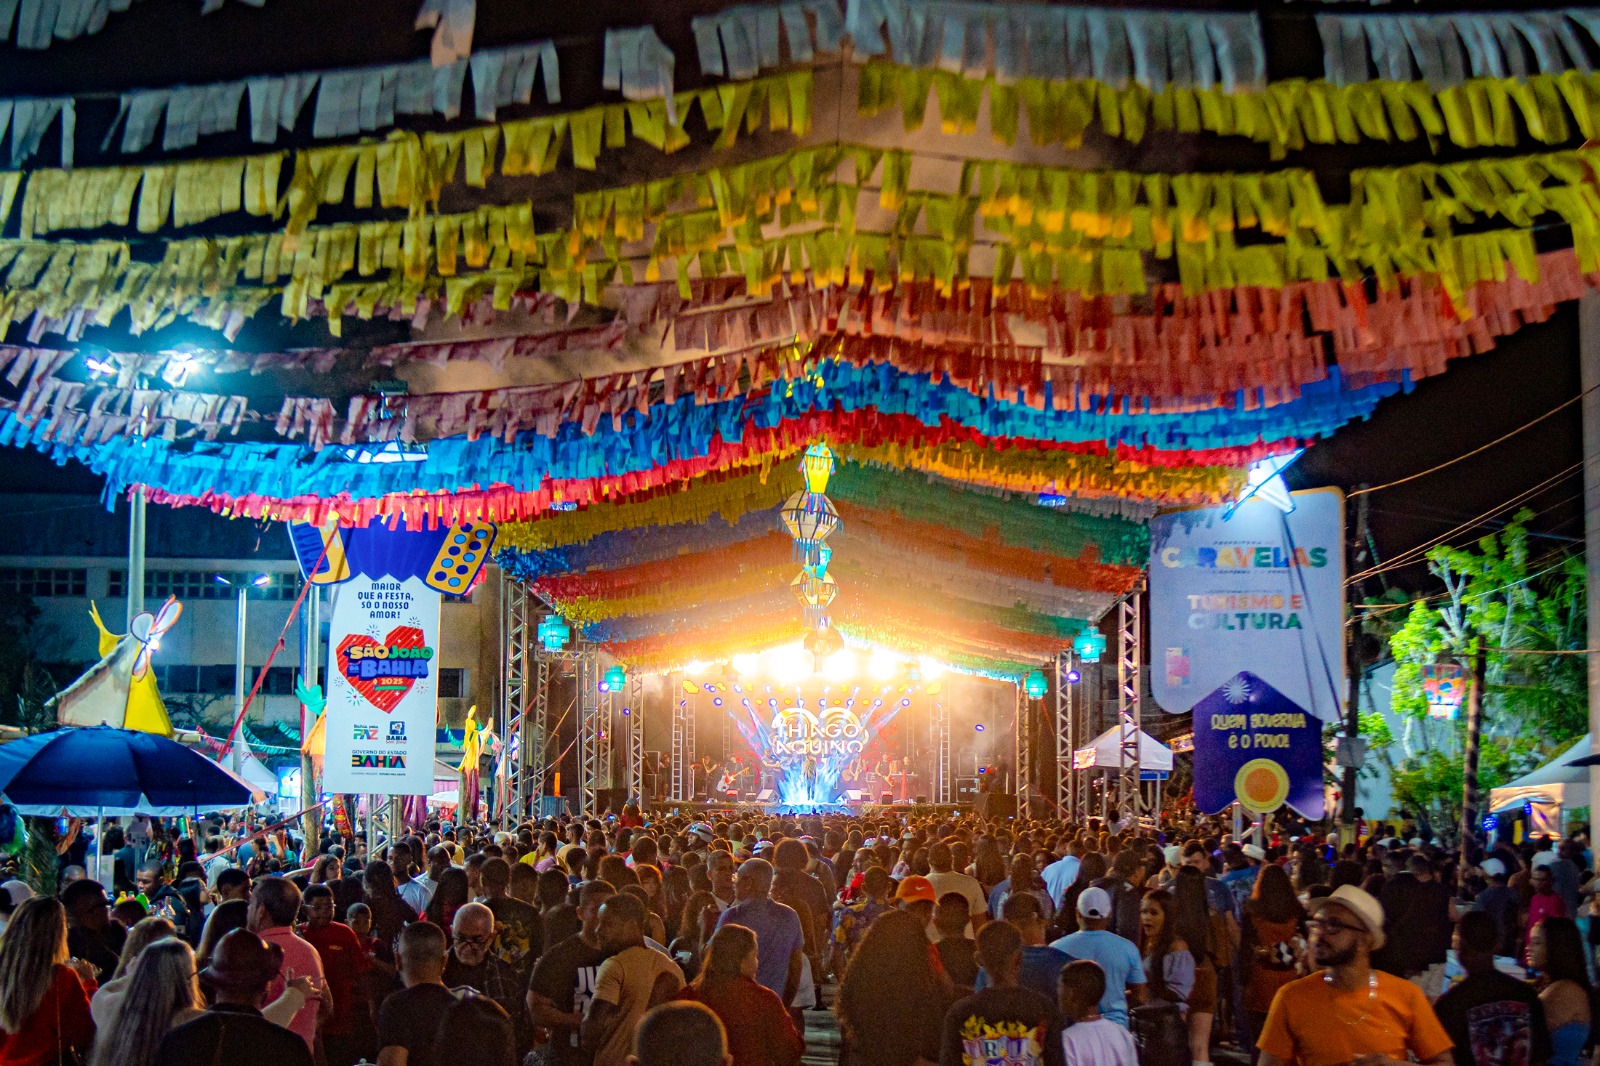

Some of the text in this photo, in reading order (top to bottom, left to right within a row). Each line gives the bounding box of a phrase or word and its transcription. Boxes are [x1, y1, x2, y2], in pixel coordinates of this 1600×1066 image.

[1161, 546, 1328, 568] CARAVELAS
[371, 583, 401, 591] MAIOR
[358, 592, 414, 601] QUE A FESTA,
[1187, 594, 1302, 610] TURISMO E
[361, 600, 409, 610] SÓ O NOSSO
[370, 611, 401, 619] AMOR!
[349, 643, 434, 660] SÃO JOÃO
[361, 659, 429, 678] BAHIA
[354, 729, 378, 740] PAZ
[779, 723, 860, 738] THIAGO
[776, 740, 863, 755] AQUINO
[1241, 734, 1251, 749] O
[352, 755, 406, 768] BAHIA
